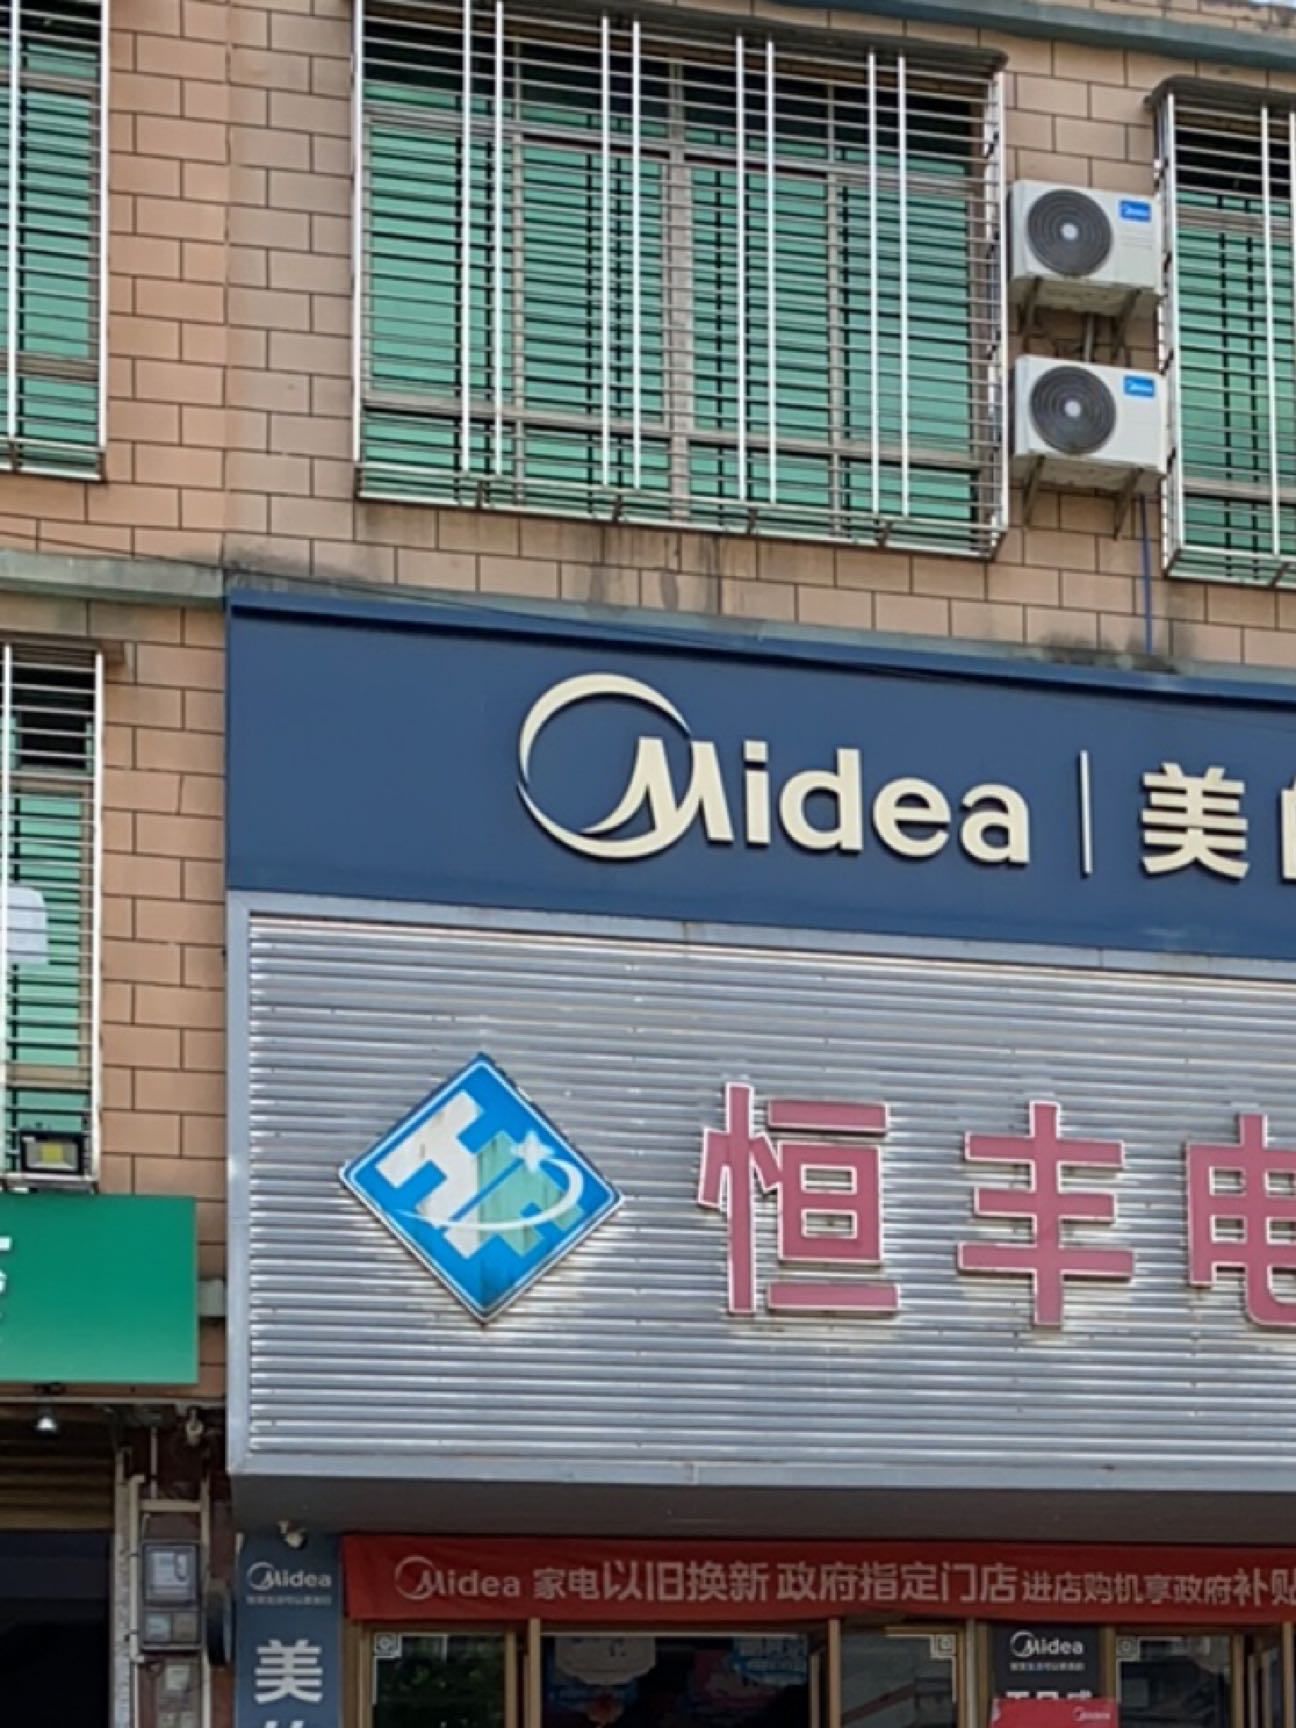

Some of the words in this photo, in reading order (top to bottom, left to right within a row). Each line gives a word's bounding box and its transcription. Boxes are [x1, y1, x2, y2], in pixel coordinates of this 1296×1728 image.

[516, 673, 1030, 865] Midea
[246, 1561, 332, 1590] Midea
[395, 1555, 520, 1600] Midea
[1009, 1630, 1084, 1658] Midea
